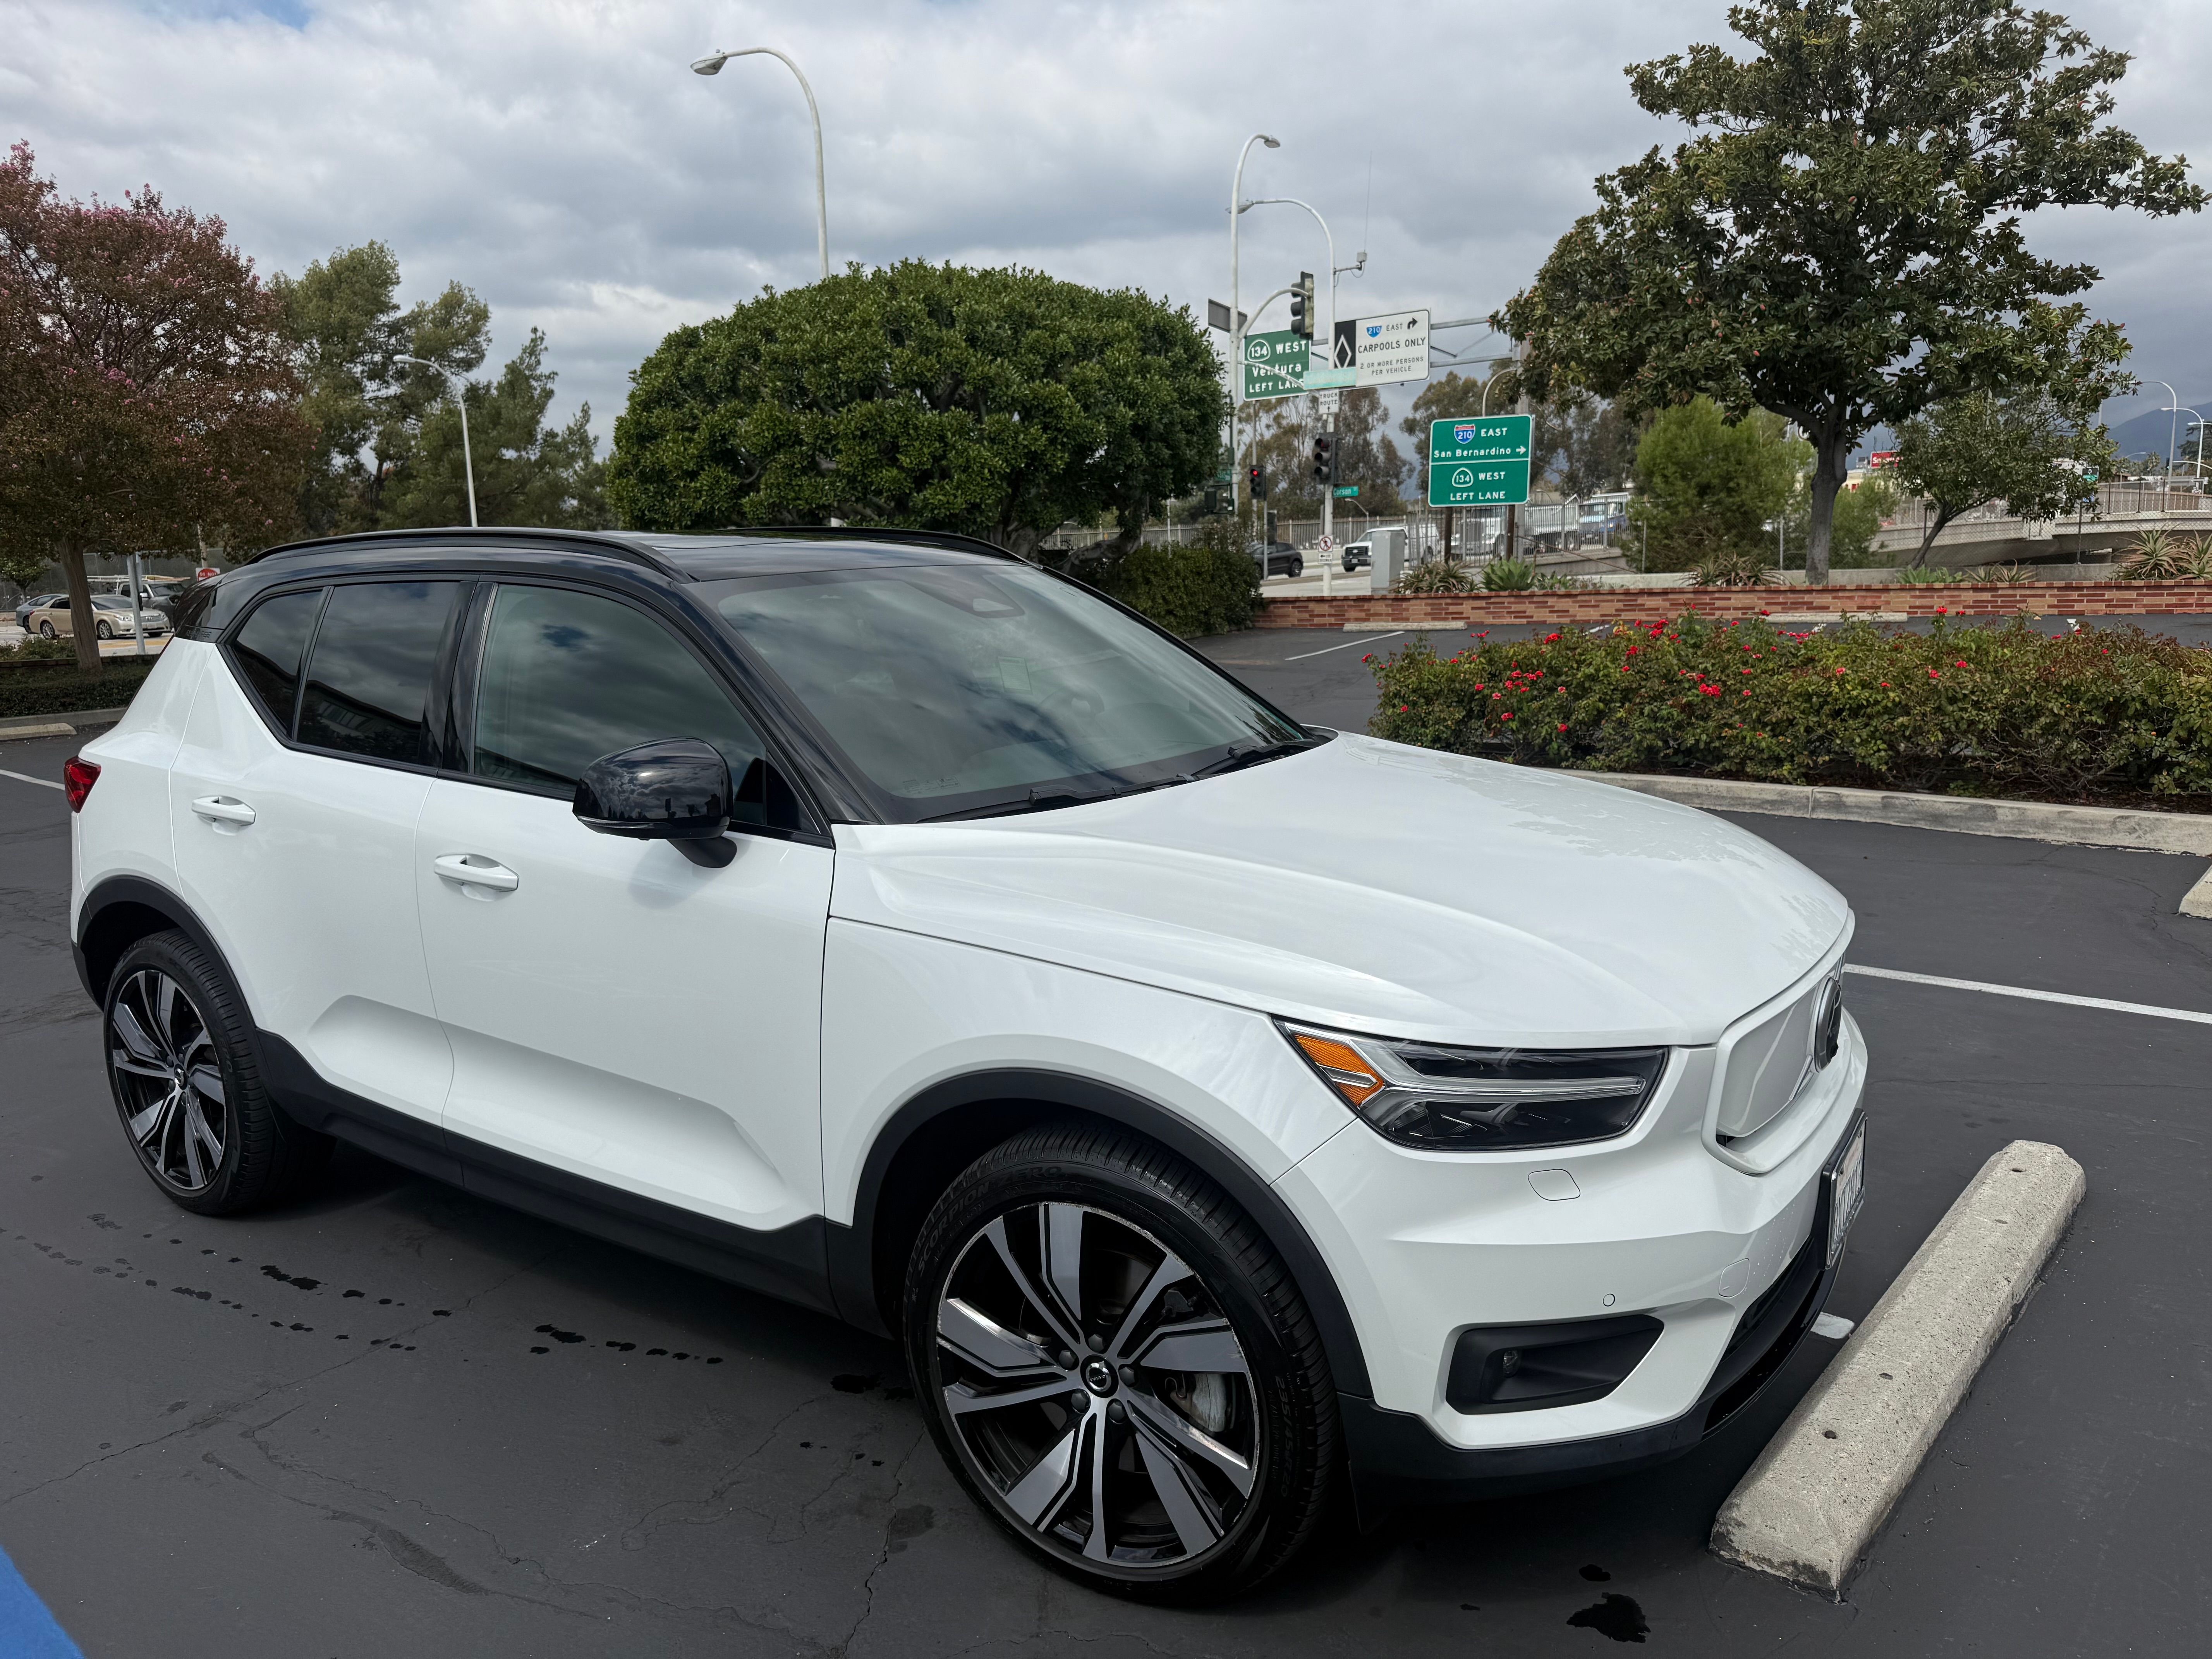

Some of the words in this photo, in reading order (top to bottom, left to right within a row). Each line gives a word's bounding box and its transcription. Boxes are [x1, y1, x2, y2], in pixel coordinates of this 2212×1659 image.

[1251, 346, 1267, 357] 134
[1276, 341, 1306, 354] WEST
[1358, 340, 1400, 353] CARPOOLS
[1405, 337, 1426, 347] ONLY
[1396, 356, 1424, 364] PERSONS
[1386, 366, 1412, 374] VEHICLE
[1249, 382, 1273, 393] LEFT
[1458, 431, 1472, 440] 210
[1481, 428, 1508, 437] EAST
[1456, 447, 1511, 457] Bernardino
[1456, 475, 1470, 483] 134
[1479, 471, 1506, 480] WEST
[1450, 492, 1474, 501] LEFT
[1479, 491, 1506, 500] LANE
[918, 1181, 989, 1278] SCORPION
